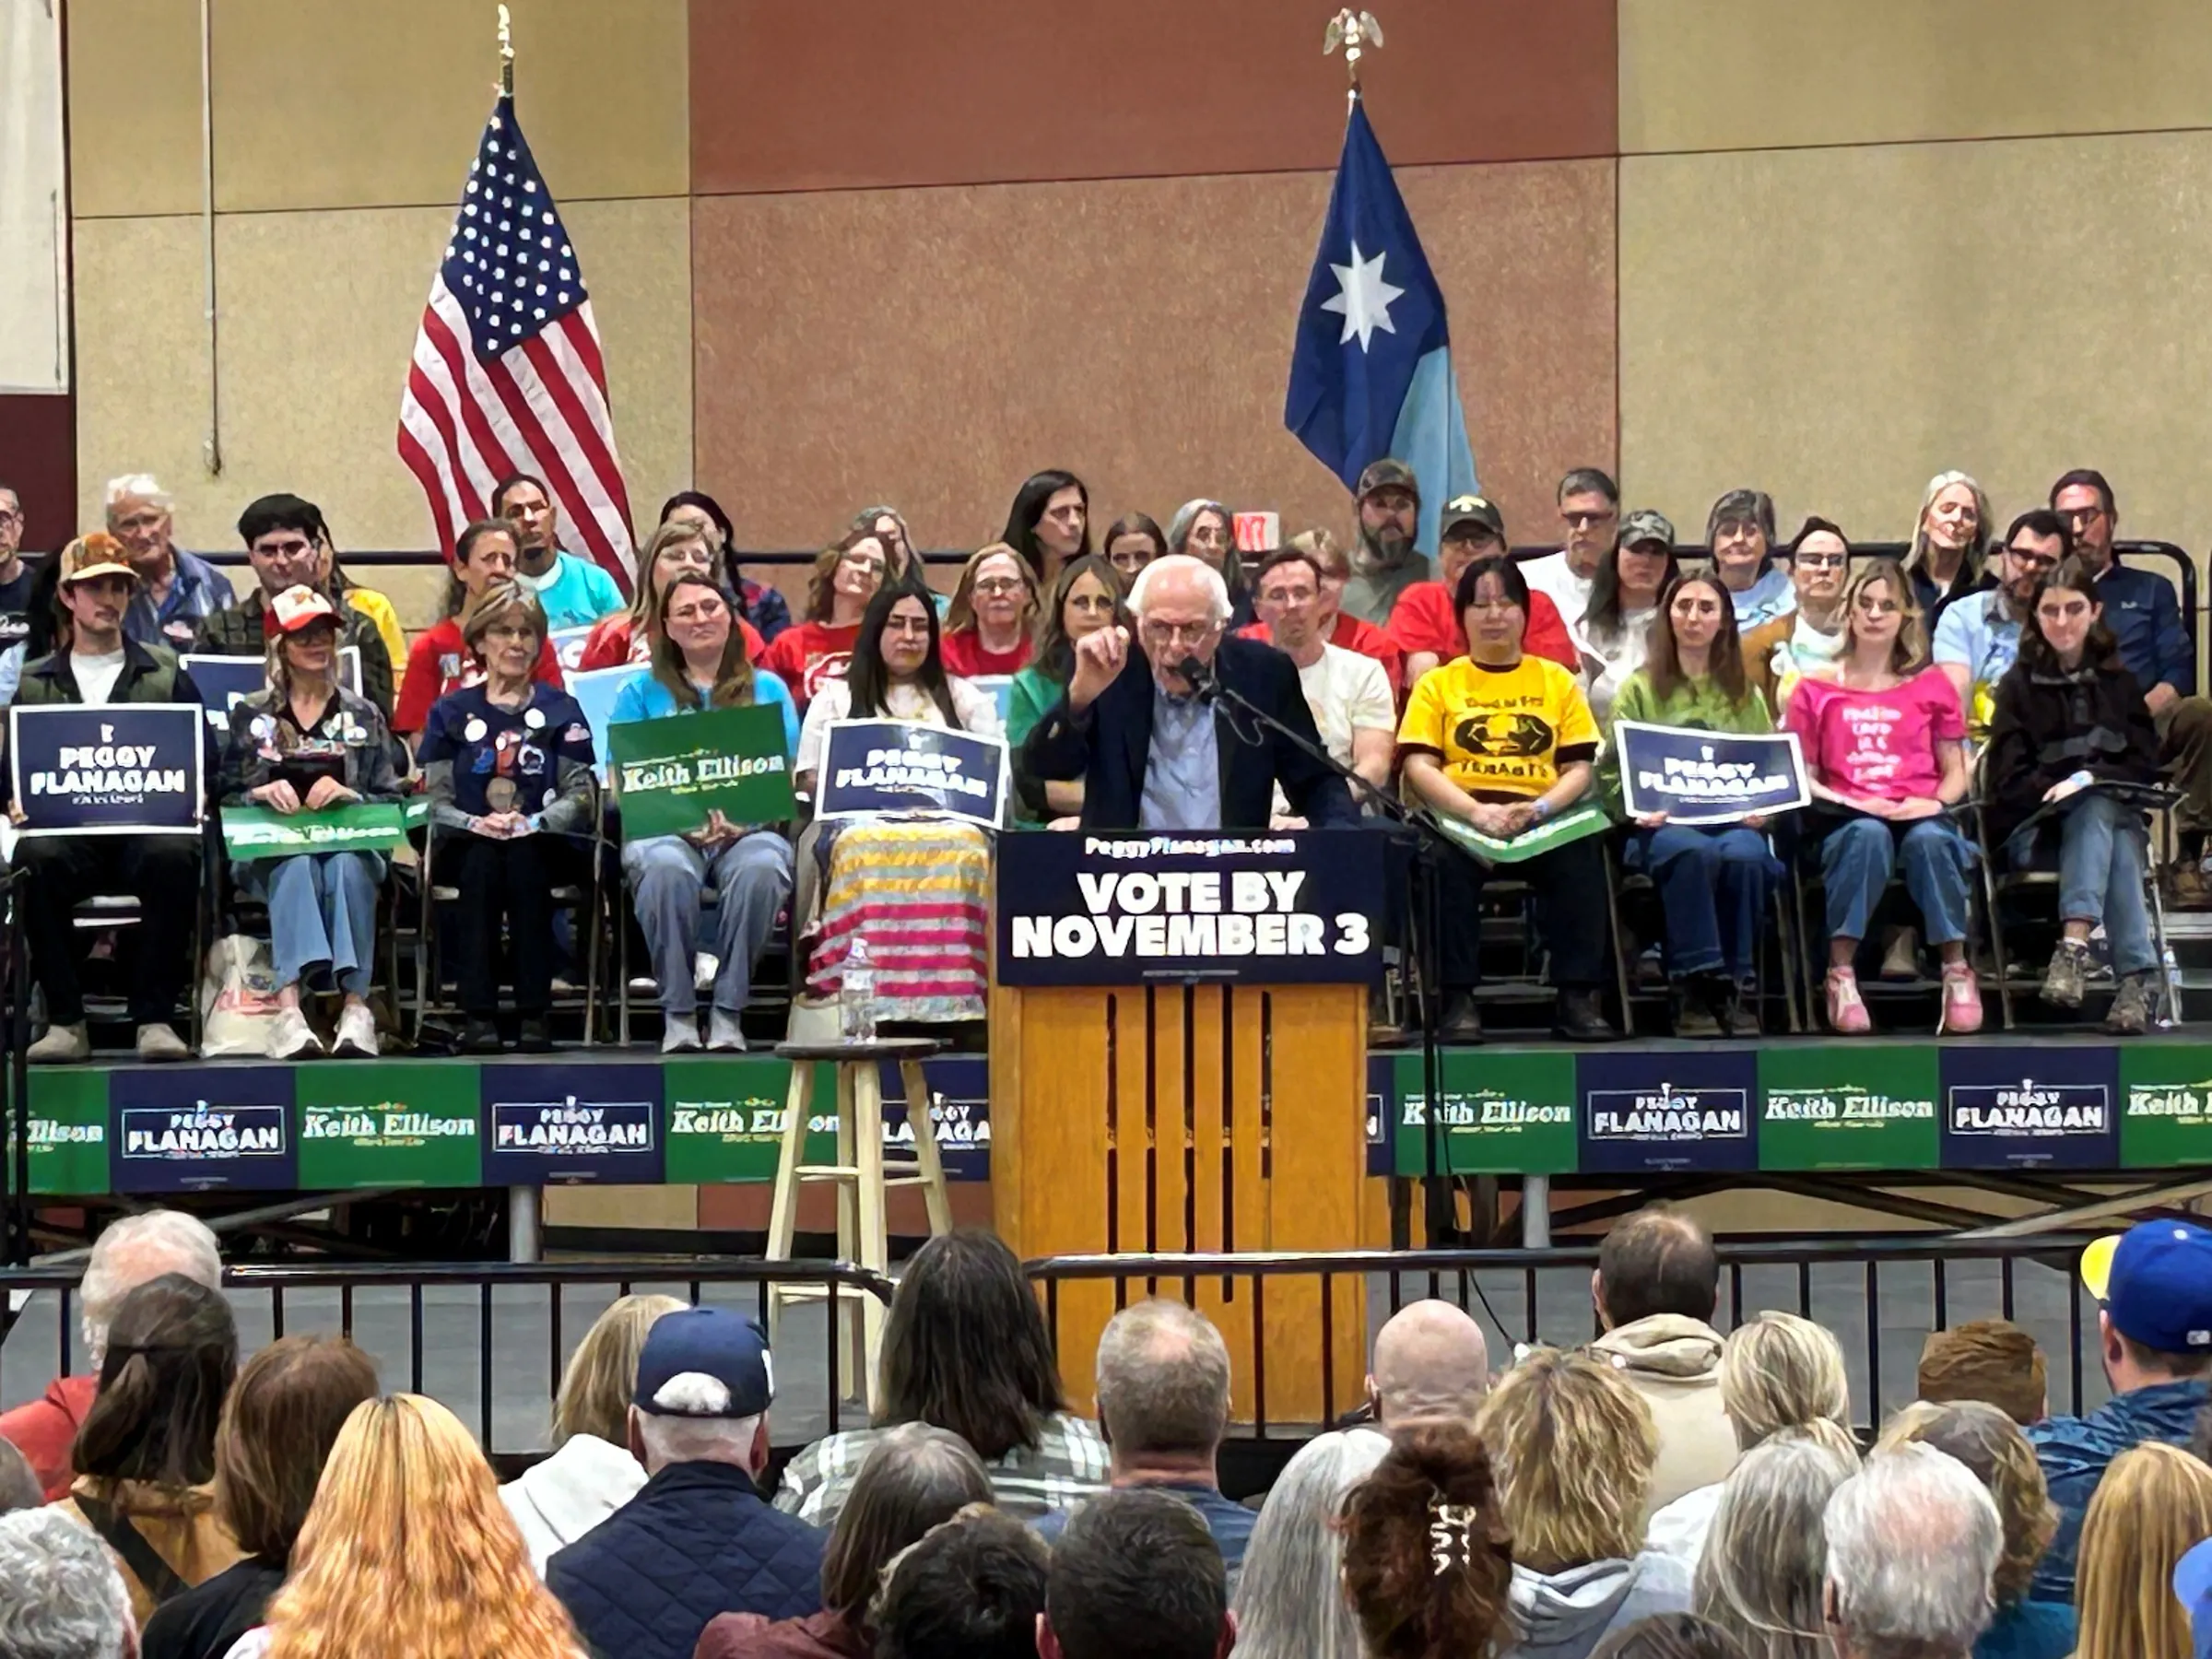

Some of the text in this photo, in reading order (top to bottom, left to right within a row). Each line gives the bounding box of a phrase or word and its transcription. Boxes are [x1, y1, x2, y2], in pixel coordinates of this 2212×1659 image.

[60, 746, 156, 769] PEGGY
[30, 770, 185, 794] FLANAGAN
[622, 763, 690, 793] Keith
[697, 755, 784, 782] Ellison
[1085, 837, 1295, 859] PeggyFlanagan.com
[1077, 871, 1306, 914] VOTE BY
[1012, 913, 1371, 958] NOVEMBER 3
[1480, 1100, 1571, 1124] Ellison
[1765, 1095, 1934, 1120] Keith Ellison
[2127, 1091, 2199, 1115] Keith
[302, 1113, 476, 1138] Keith Ellison
[671, 1110, 744, 1134] Keith
[1594, 1110, 1741, 1132] FLANAGAN
[1955, 1106, 2104, 1129] FLANAGAN
[128, 1128, 278, 1152] FLANAGAN
[498, 1124, 647, 1146] FLANAGAN
